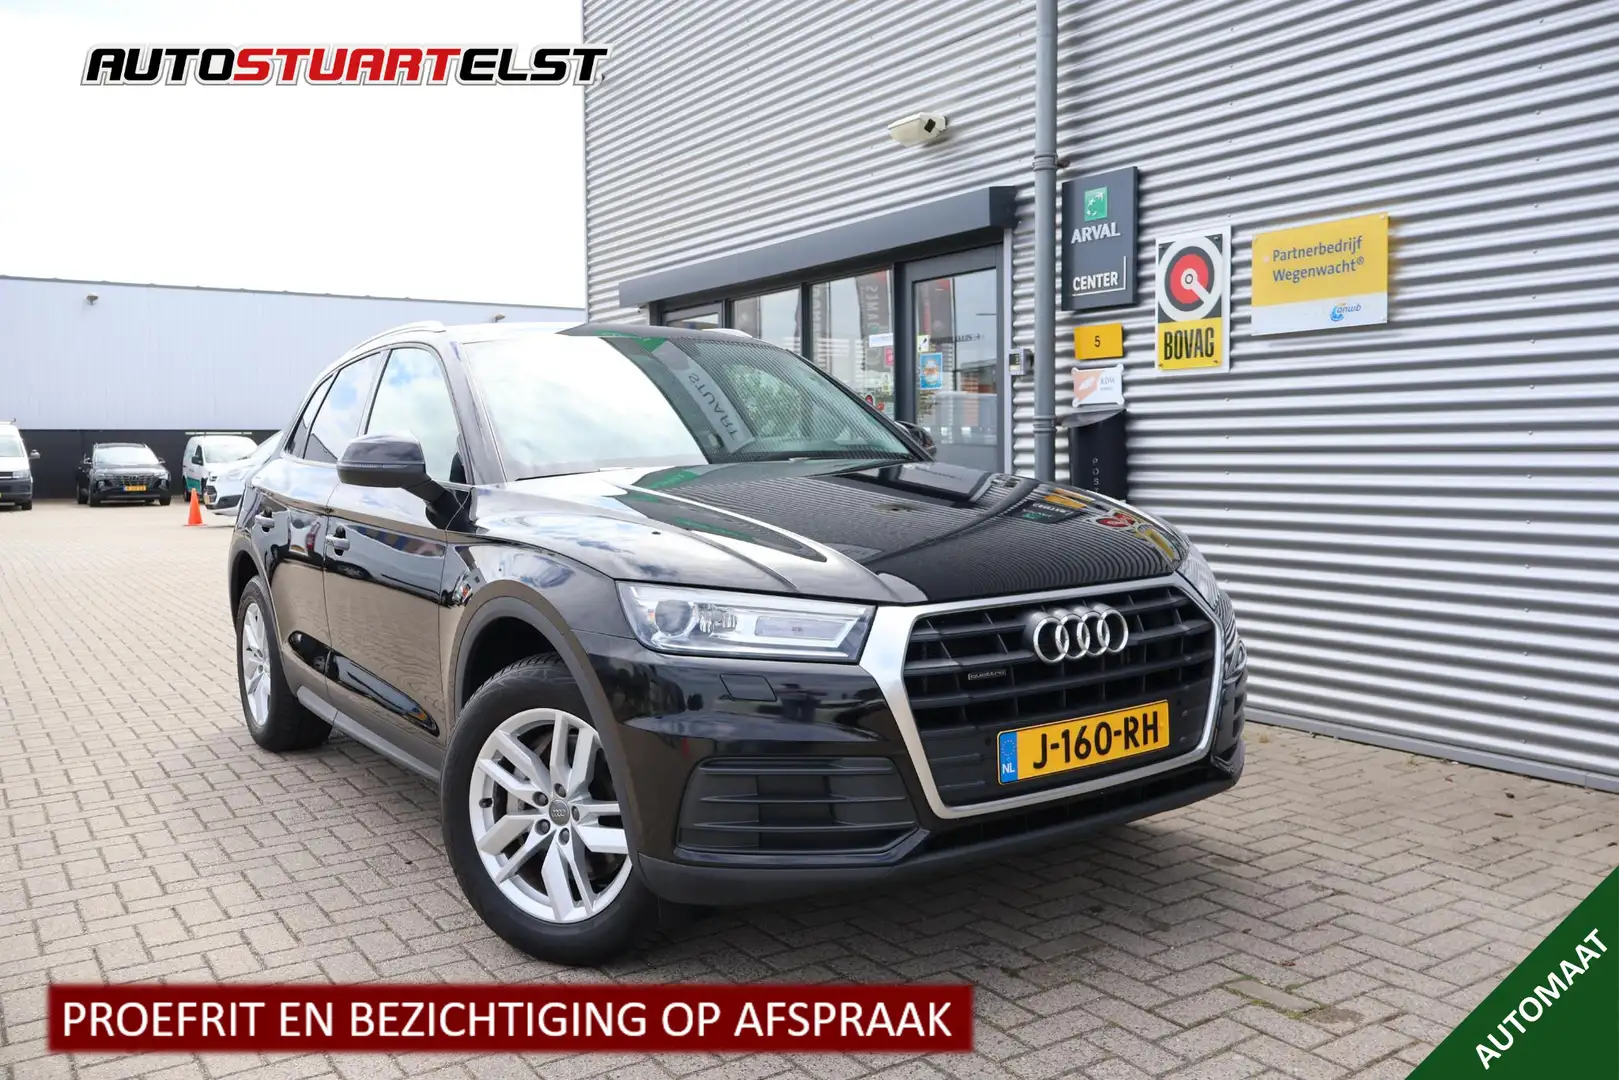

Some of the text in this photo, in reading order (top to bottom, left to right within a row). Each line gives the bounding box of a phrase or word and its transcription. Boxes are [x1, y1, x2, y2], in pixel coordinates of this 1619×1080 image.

[1071, 222, 1121, 244] ARVAL
[1273, 236, 1362, 261] Partnerbedrijf
[1073, 271, 1118, 291] CENTER
[1094, 335, 1101, 348] 5
[1164, 327, 1215, 361] BOVAG
[1032, 711, 1159, 770] J-160-RH
[1002, 763, 1015, 774] NL
